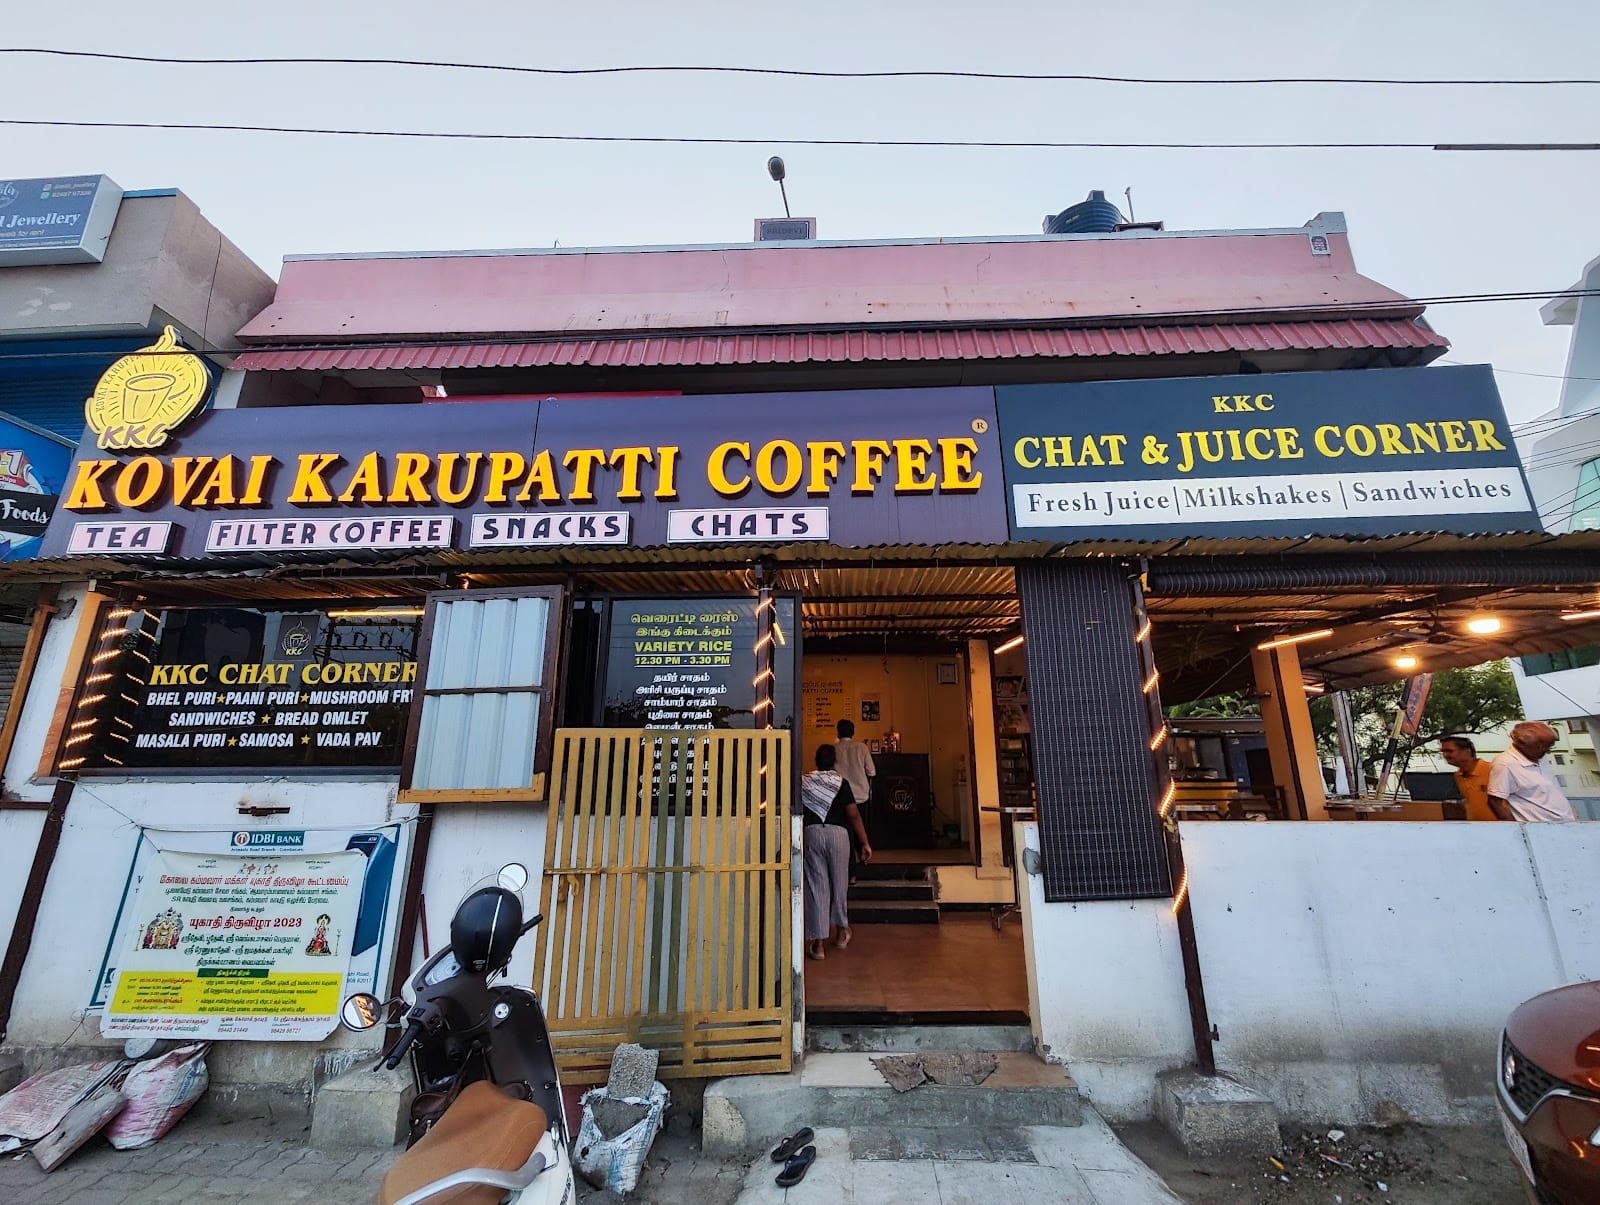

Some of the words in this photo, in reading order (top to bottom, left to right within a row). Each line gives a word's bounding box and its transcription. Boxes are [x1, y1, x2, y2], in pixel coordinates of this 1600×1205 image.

[6, 212, 81, 228] Jewellery
[1211, 393, 1275, 413] KKC
[101, 423, 167, 446] KKC
[1014, 434, 1128, 469] CHAT
[1141, 435, 1170, 465] &
[1176, 427, 1304, 473] JUICE
[1314, 419, 1507, 458] CORNER
[62, 453, 274, 510] KOVAI
[286, 446, 681, 504] KARUPATTI
[706, 437, 984, 496] COFFEE
[1183, 484, 1332, 509] Milkshakes
[1352, 478, 1512, 502] Sandwiches
[1027, 491, 1098, 513] Fresh
[1103, 490, 1170, 516] Juice
[215, 521, 317, 546] FILTER
[329, 519, 441, 544] COFFEE
[483, 514, 621, 539] SNACKS
[691, 513, 809, 537] CHATS
[86, 526, 152, 548] TEA
[635, 626, 671, 637] இங்கு
[673, 625, 733, 637] கிடைக்கும்
[634, 641, 695, 652] VARIETY
[698, 640, 733, 652] RICE
[635, 656, 663, 665] 12.30
[664, 656, 681, 665] PM
[689, 655, 712, 665] 3.30
[714, 655, 730, 664] PM
[149, 664, 209, 685] KKC
[218, 663, 295, 685] CHAT
[301, 661, 418, 685] CORNER
[653, 672, 678, 683] தயிர்
[679, 672, 711, 683] சாதம்
[146, 692, 181, 706] BHEL
[184, 691, 217, 706] PURI
[225, 691, 264, 705] PAANI
[267, 691, 300, 705] PURI
[309, 690, 389, 705] MUSHROOM
[696, 684, 728, 695] சாதம்
[686, 696, 718, 707] சாதம்
[168, 711, 256, 726] SANDWICHES
[274, 711, 320, 726] BREAD
[322, 711, 369, 726] OMLET
[682, 709, 713, 720] சாதம்
[135, 733, 190, 748] MASALA
[193, 733, 227, 747] PURI
[238, 733, 294, 747] SAMOSA
[316, 732, 351, 747] VADA
[354, 731, 382, 746] PAV
[251, 833, 276, 844] IDBI
[277, 835, 302, 844] BANK
[190, 915, 223, 930] யுகாதி
[223, 915, 272, 931] திருவிழா
[273, 917, 303, 928] 2023
